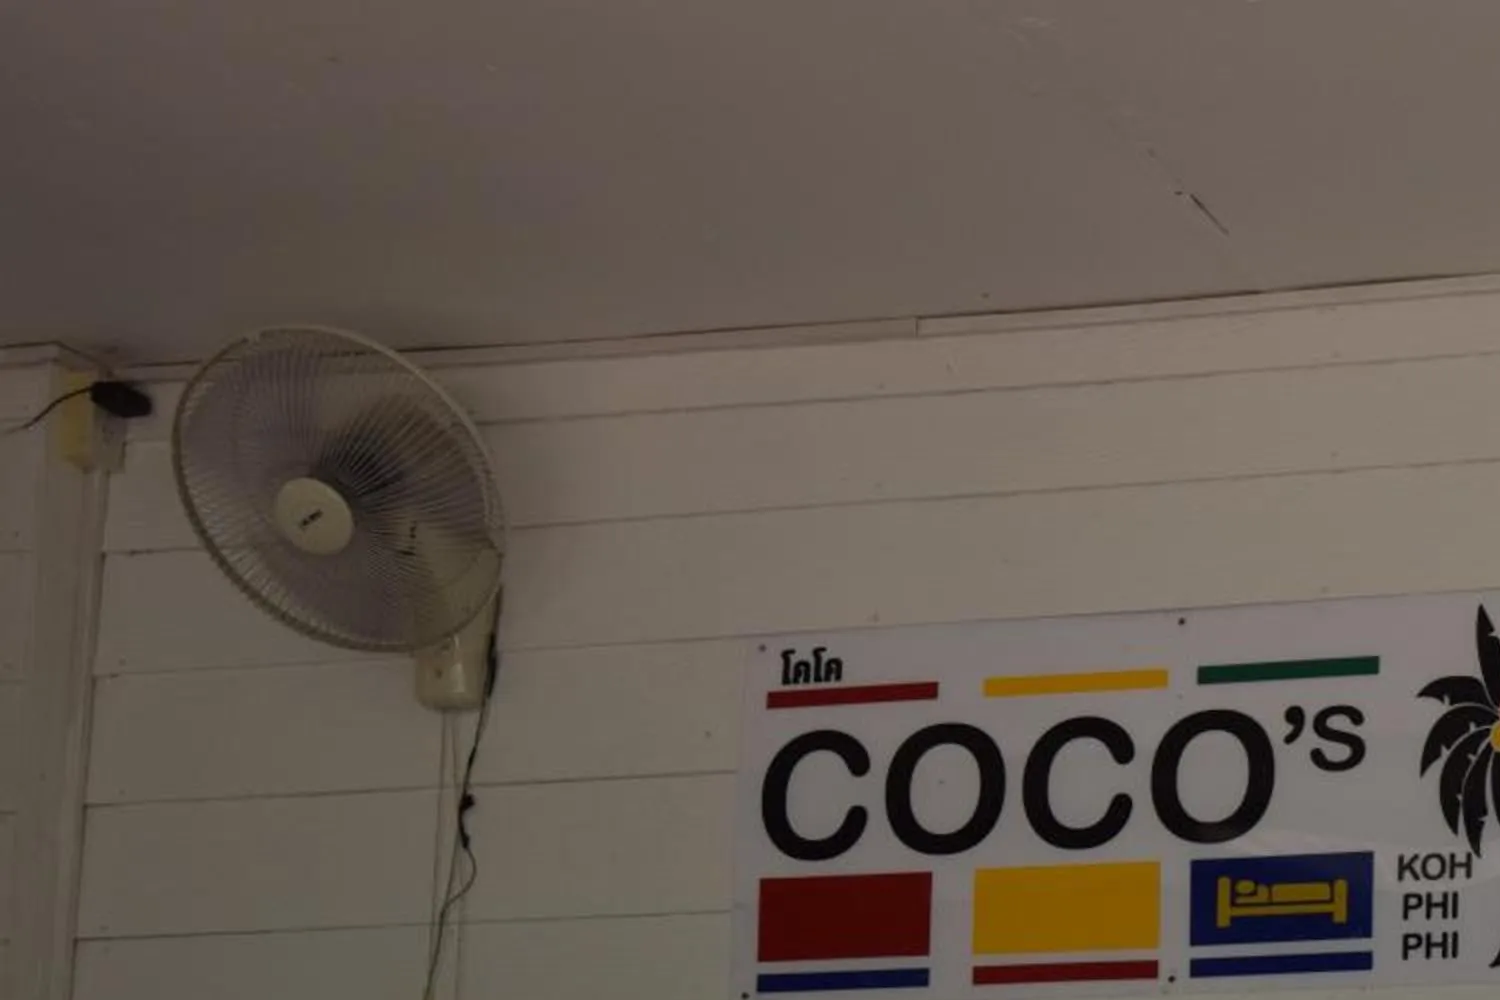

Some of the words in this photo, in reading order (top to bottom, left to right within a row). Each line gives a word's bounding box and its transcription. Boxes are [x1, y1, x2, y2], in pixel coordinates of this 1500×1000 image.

[780, 645, 844, 686] โคโค
[1397, 850, 1473, 883] KOH
[1401, 890, 1459, 921] PHI
[1401, 929, 1459, 960] PHI
